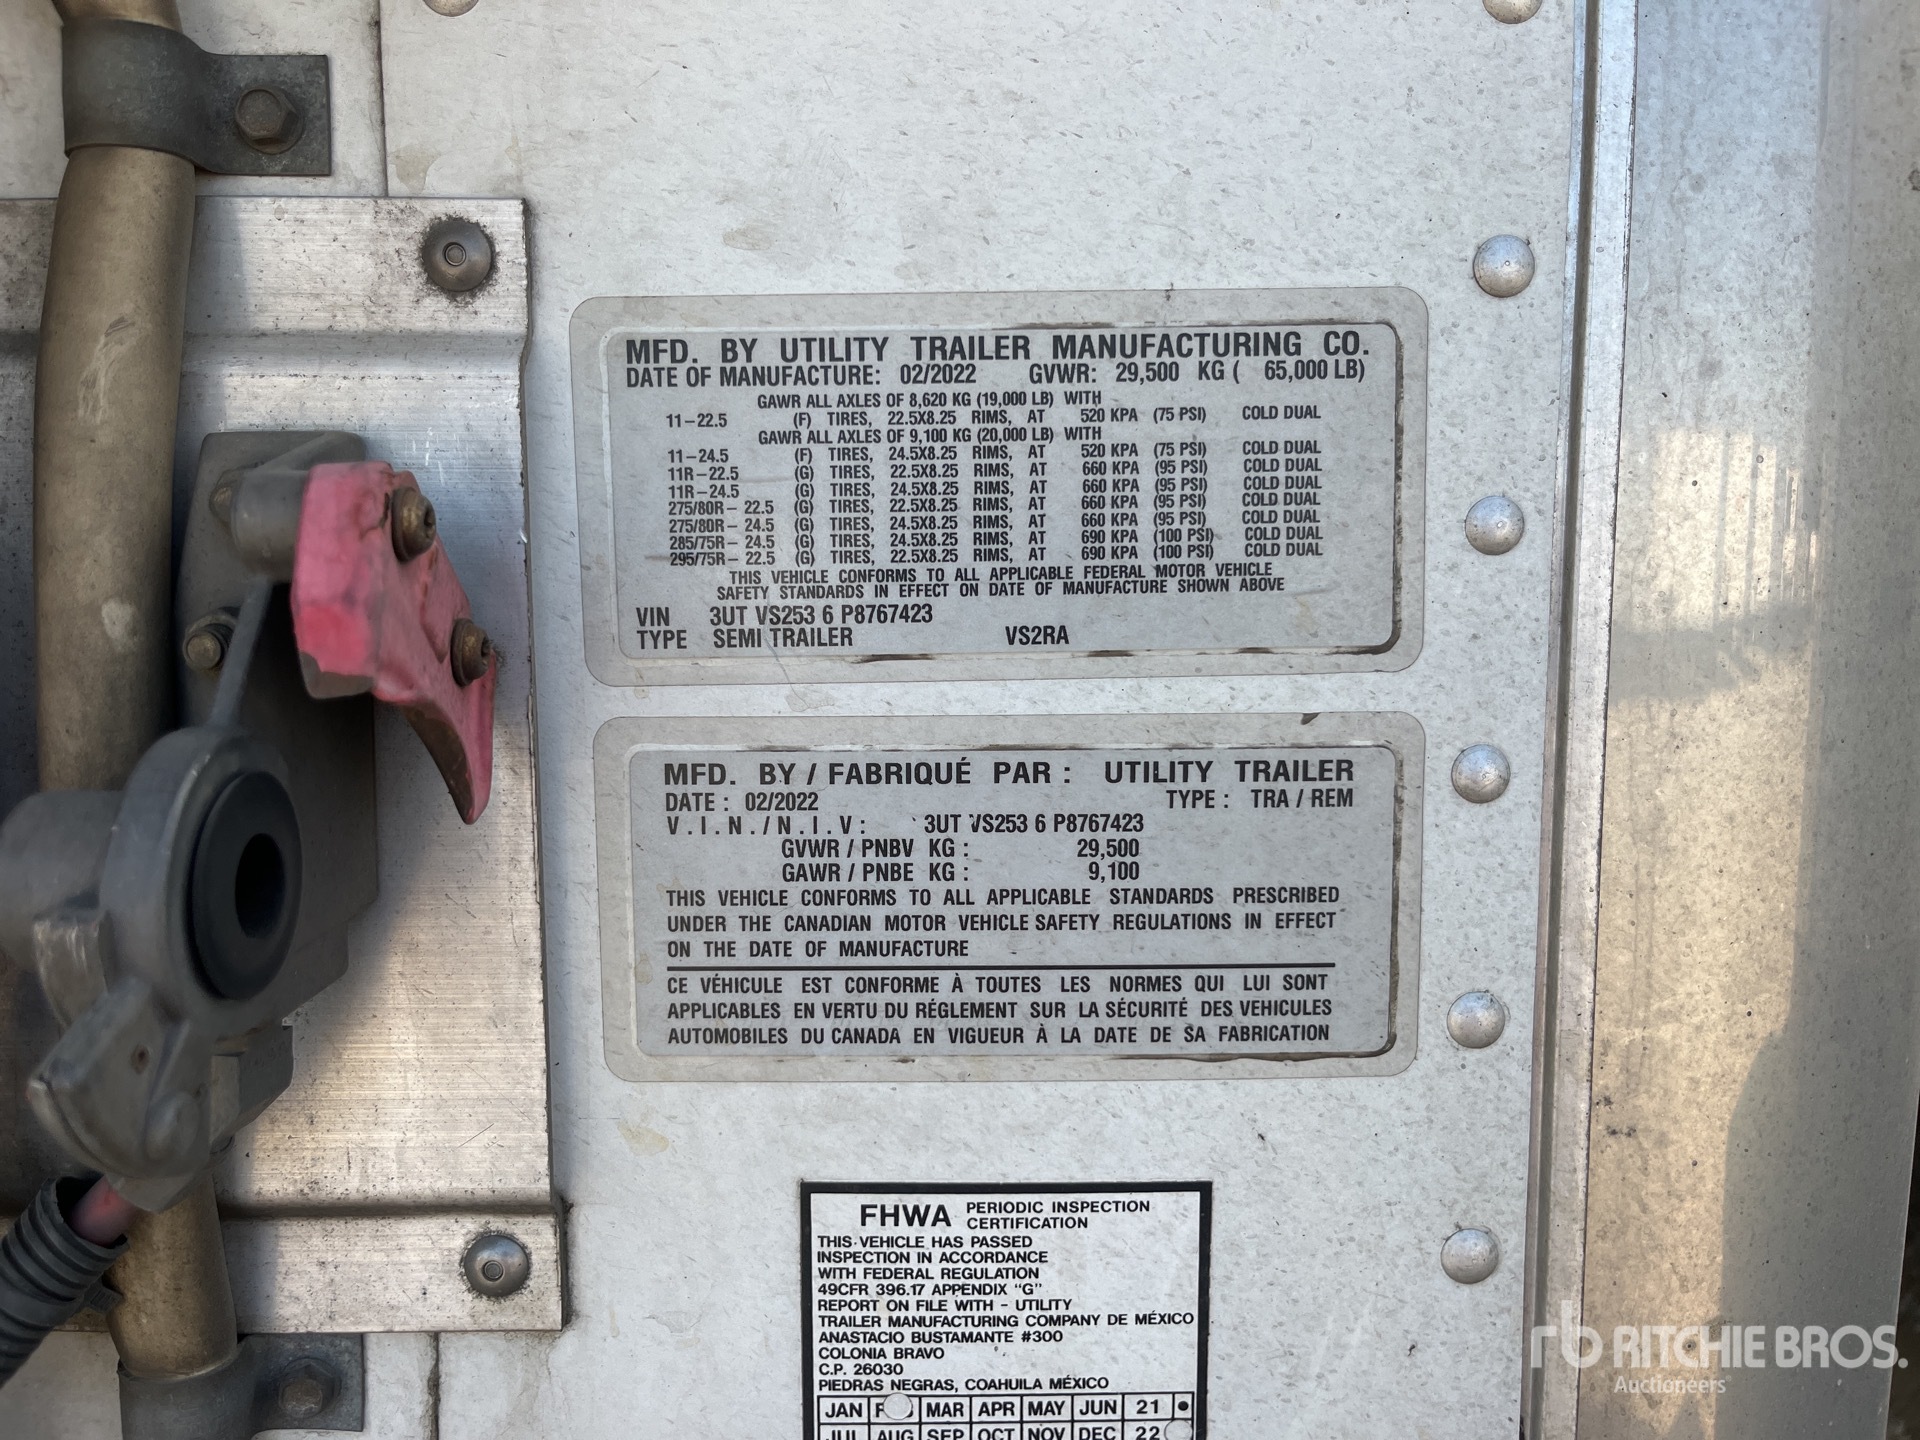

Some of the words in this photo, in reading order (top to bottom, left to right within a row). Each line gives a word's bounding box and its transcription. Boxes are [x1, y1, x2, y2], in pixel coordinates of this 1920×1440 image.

[625, 339, 699, 364] MFD.
[720, 338, 759, 363] BY
[780, 337, 890, 363] UTILITY
[909, 335, 1031, 361] TRAILER
[1052, 332, 1302, 359] MANUFACTURING
[1323, 331, 1370, 356] CO.
[626, 367, 678, 387] DATE
[685, 366, 712, 387] OF
[719, 365, 881, 386] MANUFACTURE:
[899, 363, 977, 384] 02/2022
[1029, 363, 1097, 384] GVWR:
[1115, 362, 1180, 385] 29,500
[1264, 361, 1329, 383] 65,000
[1334, 360, 1366, 383] LB)
[757, 394, 802, 409] GAWR
[805, 394, 833, 408] ALL
[836, 393, 881, 408] AXLES
[885, 393, 905, 407] OF
[908, 392, 948, 411] 8,620
[952, 392, 972, 406] KG
[976, 391, 1027, 409] (19,000
[1031, 391, 1054, 410] LB)
[1063, 391, 1102, 407] WITH
[793, 412, 812, 429] (F)
[826, 411, 873, 428] TIRES,
[887, 410, 957, 425] 22.5X8.25
[971, 408, 1012, 428] RIMS,
[1026, 409, 1046, 423] AT
[1080, 408, 1106, 423] 520
[1110, 408, 1139, 422] KPA
[1152, 407, 1175, 424] (75
[1178, 407, 1207, 423] PSI)
[1241, 406, 1279, 420] COLD
[1283, 405, 1322, 419] DUAL
[729, 571, 762, 587] THIS
[770, 570, 829, 586] VEHICLE
[838, 569, 917, 585] CONFORMS
[926, 568, 945, 584] TO
[954, 568, 981, 584] ALL
[989, 566, 1074, 583] APPLICABLE
[1083, 565, 1147, 581] FEDERAL
[1152, 564, 1206, 580] MOTOR
[1214, 562, 1273, 579] VEHICLE
[635, 607, 670, 626] VIN
[709, 606, 748, 629] 3UT
[754, 605, 816, 625] VS253
[822, 605, 834, 624] 6
[841, 604, 933, 624] P8767423
[636, 630, 688, 649] TYPE
[713, 628, 762, 648] SEMI
[769, 627, 854, 647] TRAILER
[1004, 625, 1070, 645] VS2RA
[663, 763, 736, 785] MFD.
[828, 757, 971, 785] FABRIQUÉ
[1104, 761, 1214, 783] UTILITY
[1233, 759, 1354, 782] TRAILER
[924, 814, 962, 833] 3UT
[968, 814, 1029, 833] VS253
[1034, 814, 1047, 833] 6
[1053, 813, 1145, 832] P8767423
[1076, 838, 1140, 862] 29,500
[1088, 861, 1140, 883] 9,100
[665, 890, 706, 906] THIS
[717, 890, 789, 906] VEHICLE
[800, 889, 897, 906] CONFORMS
[908, 889, 932, 905] TO
[942, 889, 976, 905] ALL
[986, 888, 1091, 905] APPLICABLE
[1109, 887, 1214, 905] STANDARDS
[1232, 887, 1340, 903] PRESCRIBED
[667, 977, 689, 994] CE
[699, 973, 783, 993] VÉHICULE
[801, 977, 833, 993] EST
[844, 977, 940, 993] CONFORME
[951, 973, 964, 993] À
[974, 976, 1042, 993] TOUTES
[1060, 976, 1091, 992] LES
[1109, 975, 1183, 992] NORMES
[1194, 975, 1224, 992] QUI
[1243, 975, 1270, 991] LUI
[1282, 974, 1329, 991] SONT
[667, 1028, 789, 1044] AUTOMOBILES
[801, 1028, 825, 1044] DU
[831, 1028, 902, 1044] CANADA
[913, 1028, 935, 1043] EN
[947, 1027, 1024, 1044] VIGUEUR
[1035, 1023, 1048, 1043] À
[1060, 1027, 1082, 1043] LA
[1094, 1027, 1138, 1043] DATE
[1150, 1027, 1172, 1042] DE
[1183, 1025, 1207, 1042] SA
[1218, 1024, 1330, 1041] FABRICATION
[860, 1204, 952, 1227] FHWA
[966, 1202, 1044, 1213] PERIODIC
[1051, 1201, 1150, 1213] INSPECTION
[966, 1217, 1088, 1229] CERTIFICATION
[817, 1236, 851, 1248] THIS
[859, 1236, 925, 1248] VEHICLE
[931, 1236, 964, 1248] HAS
[970, 1236, 1033, 1248] PASSED
[817, 1251, 911, 1263] INSPECTION
[916, 1252, 933, 1263] IN
[938, 1251, 1049, 1264] ACCORDANCE
[817, 1267, 857, 1279] WITH
[863, 1268, 935, 1279] FEDERAL
[940, 1267, 1040, 1279] REGULATION
[817, 1283, 869, 1295] 49CFR
[875, 1284, 926, 1296] 396.17
[931, 1283, 1008, 1297] APPENDIX
[817, 1299, 880, 1311] REPORT
[885, 1300, 910, 1312] ON
[915, 1300, 948, 1311] FILE
[954, 1300, 994, 1311] WITH
[1015, 1299, 1073, 1311] UTILITY
[818, 1315, 882, 1327] TRAILER
[887, 1315, 1019, 1327] MANUFACTURING
[1025, 1315, 1101, 1327] COMPANY
[1107, 1314, 1128, 1325] DE
[1134, 1310, 1195, 1325] MÉXICO
[818, 1331, 905, 1343] ANASTACIO
[911, 1331, 1014, 1343] BUSTAMANTE
[1020, 1330, 1064, 1342] #300
[818, 1347, 888, 1359] COLONIA
[893, 1347, 945, 1359] BRAVO
[818, 1364, 847, 1375] C.P.
[853, 1363, 904, 1375] 26030
[818, 1379, 884, 1391] PIEDRAS
[890, 1379, 959, 1394] NEGRAS,
[964, 1379, 1043, 1390] COAHUILA
[1049, 1375, 1110, 1389] MÉXICO
[825, 1402, 863, 1418] JAN
[926, 1402, 964, 1418] MAR
[977, 1401, 1015, 1417] APR
[1028, 1400, 1065, 1416] MAY
[1079, 1399, 1117, 1415] JUN
[1136, 1399, 1159, 1414] 21
